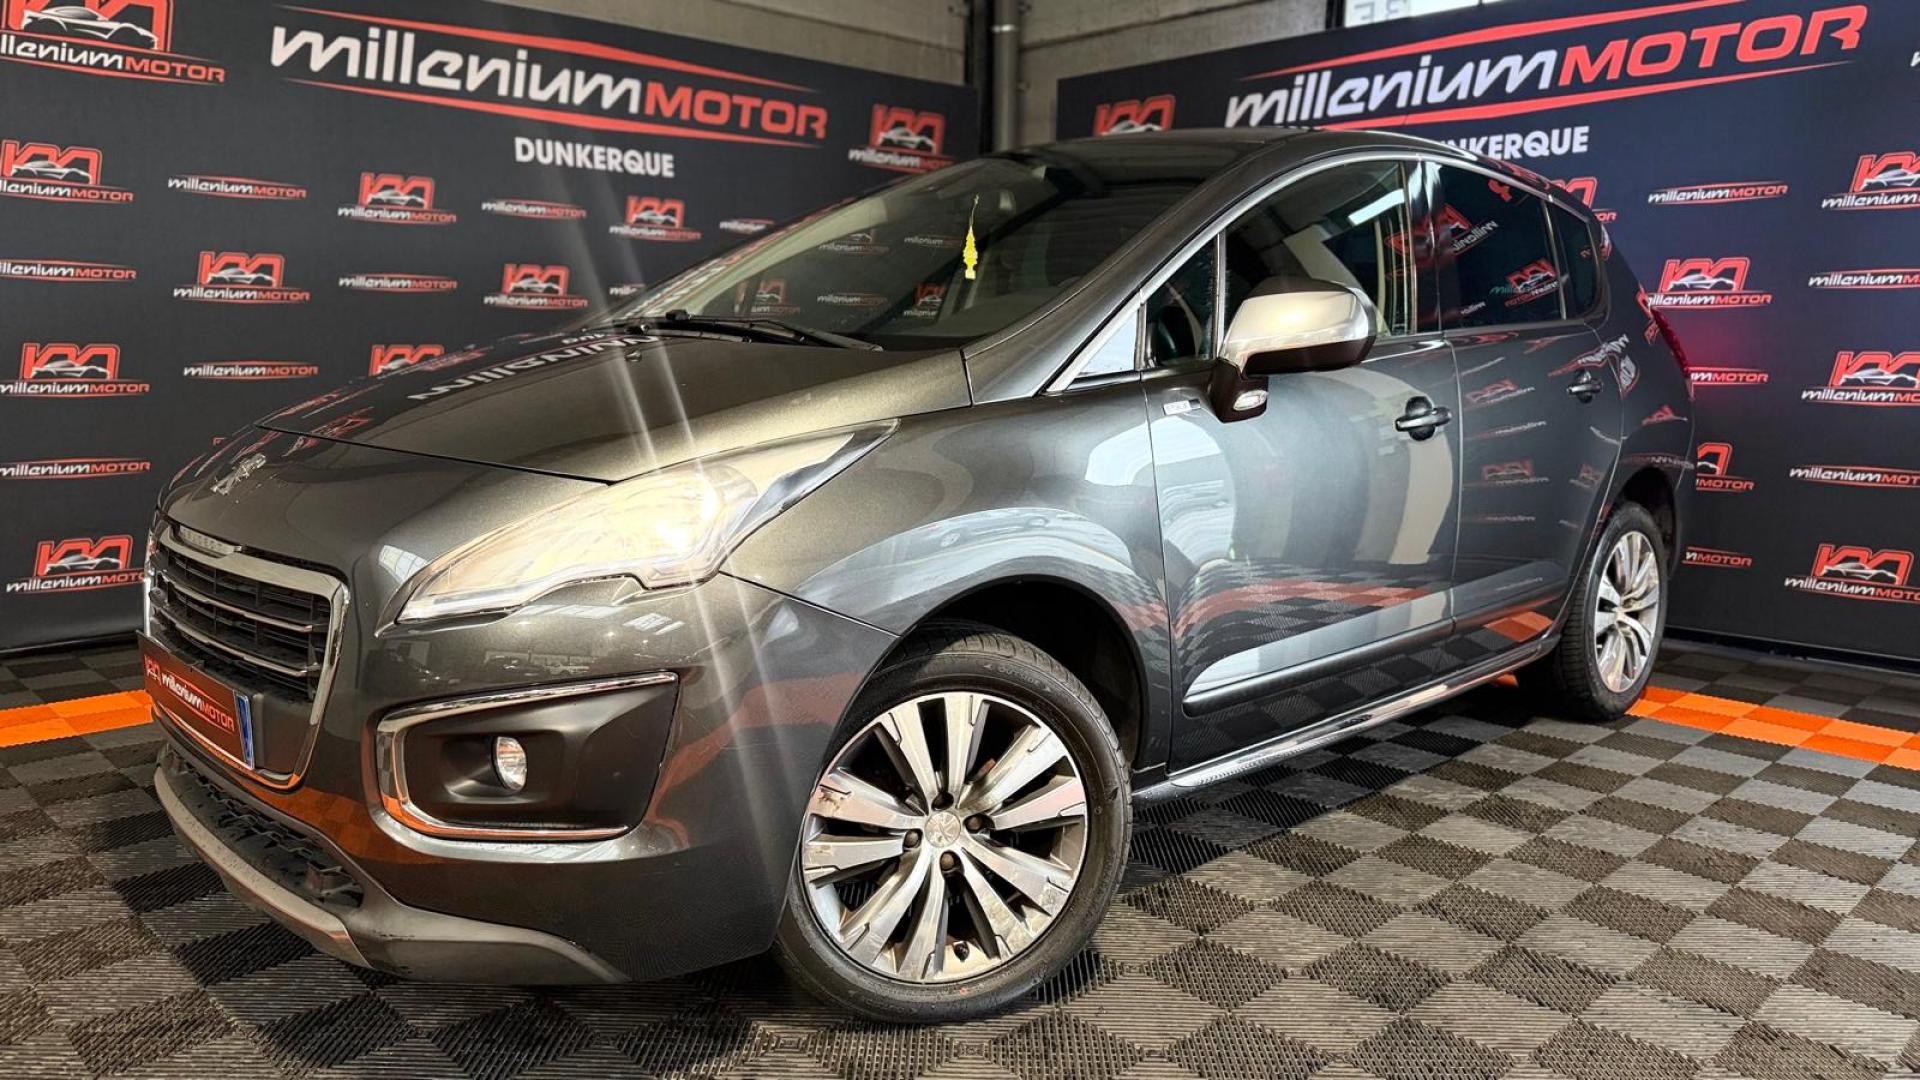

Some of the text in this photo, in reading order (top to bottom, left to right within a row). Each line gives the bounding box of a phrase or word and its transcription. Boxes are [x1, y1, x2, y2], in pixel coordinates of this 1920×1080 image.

[0, 33, 225, 83] lleniumMOTOR
[1225, 4, 1868, 129] milleniumMOTOR
[271, 26, 828, 139] milleniumMOTOR
[515, 137, 674, 178] DUNKERQUE
[168, 176, 307, 199] milleniumMOTOR
[1647, 184, 1789, 204] milleniumMOTOR
[1821, 192, 1920, 209] millenium
[173, 286, 311, 302] milleniumMOTOR
[183, 363, 319, 377] milleniumMOTOR
[1789, 467, 1920, 485] milleniumMOT
